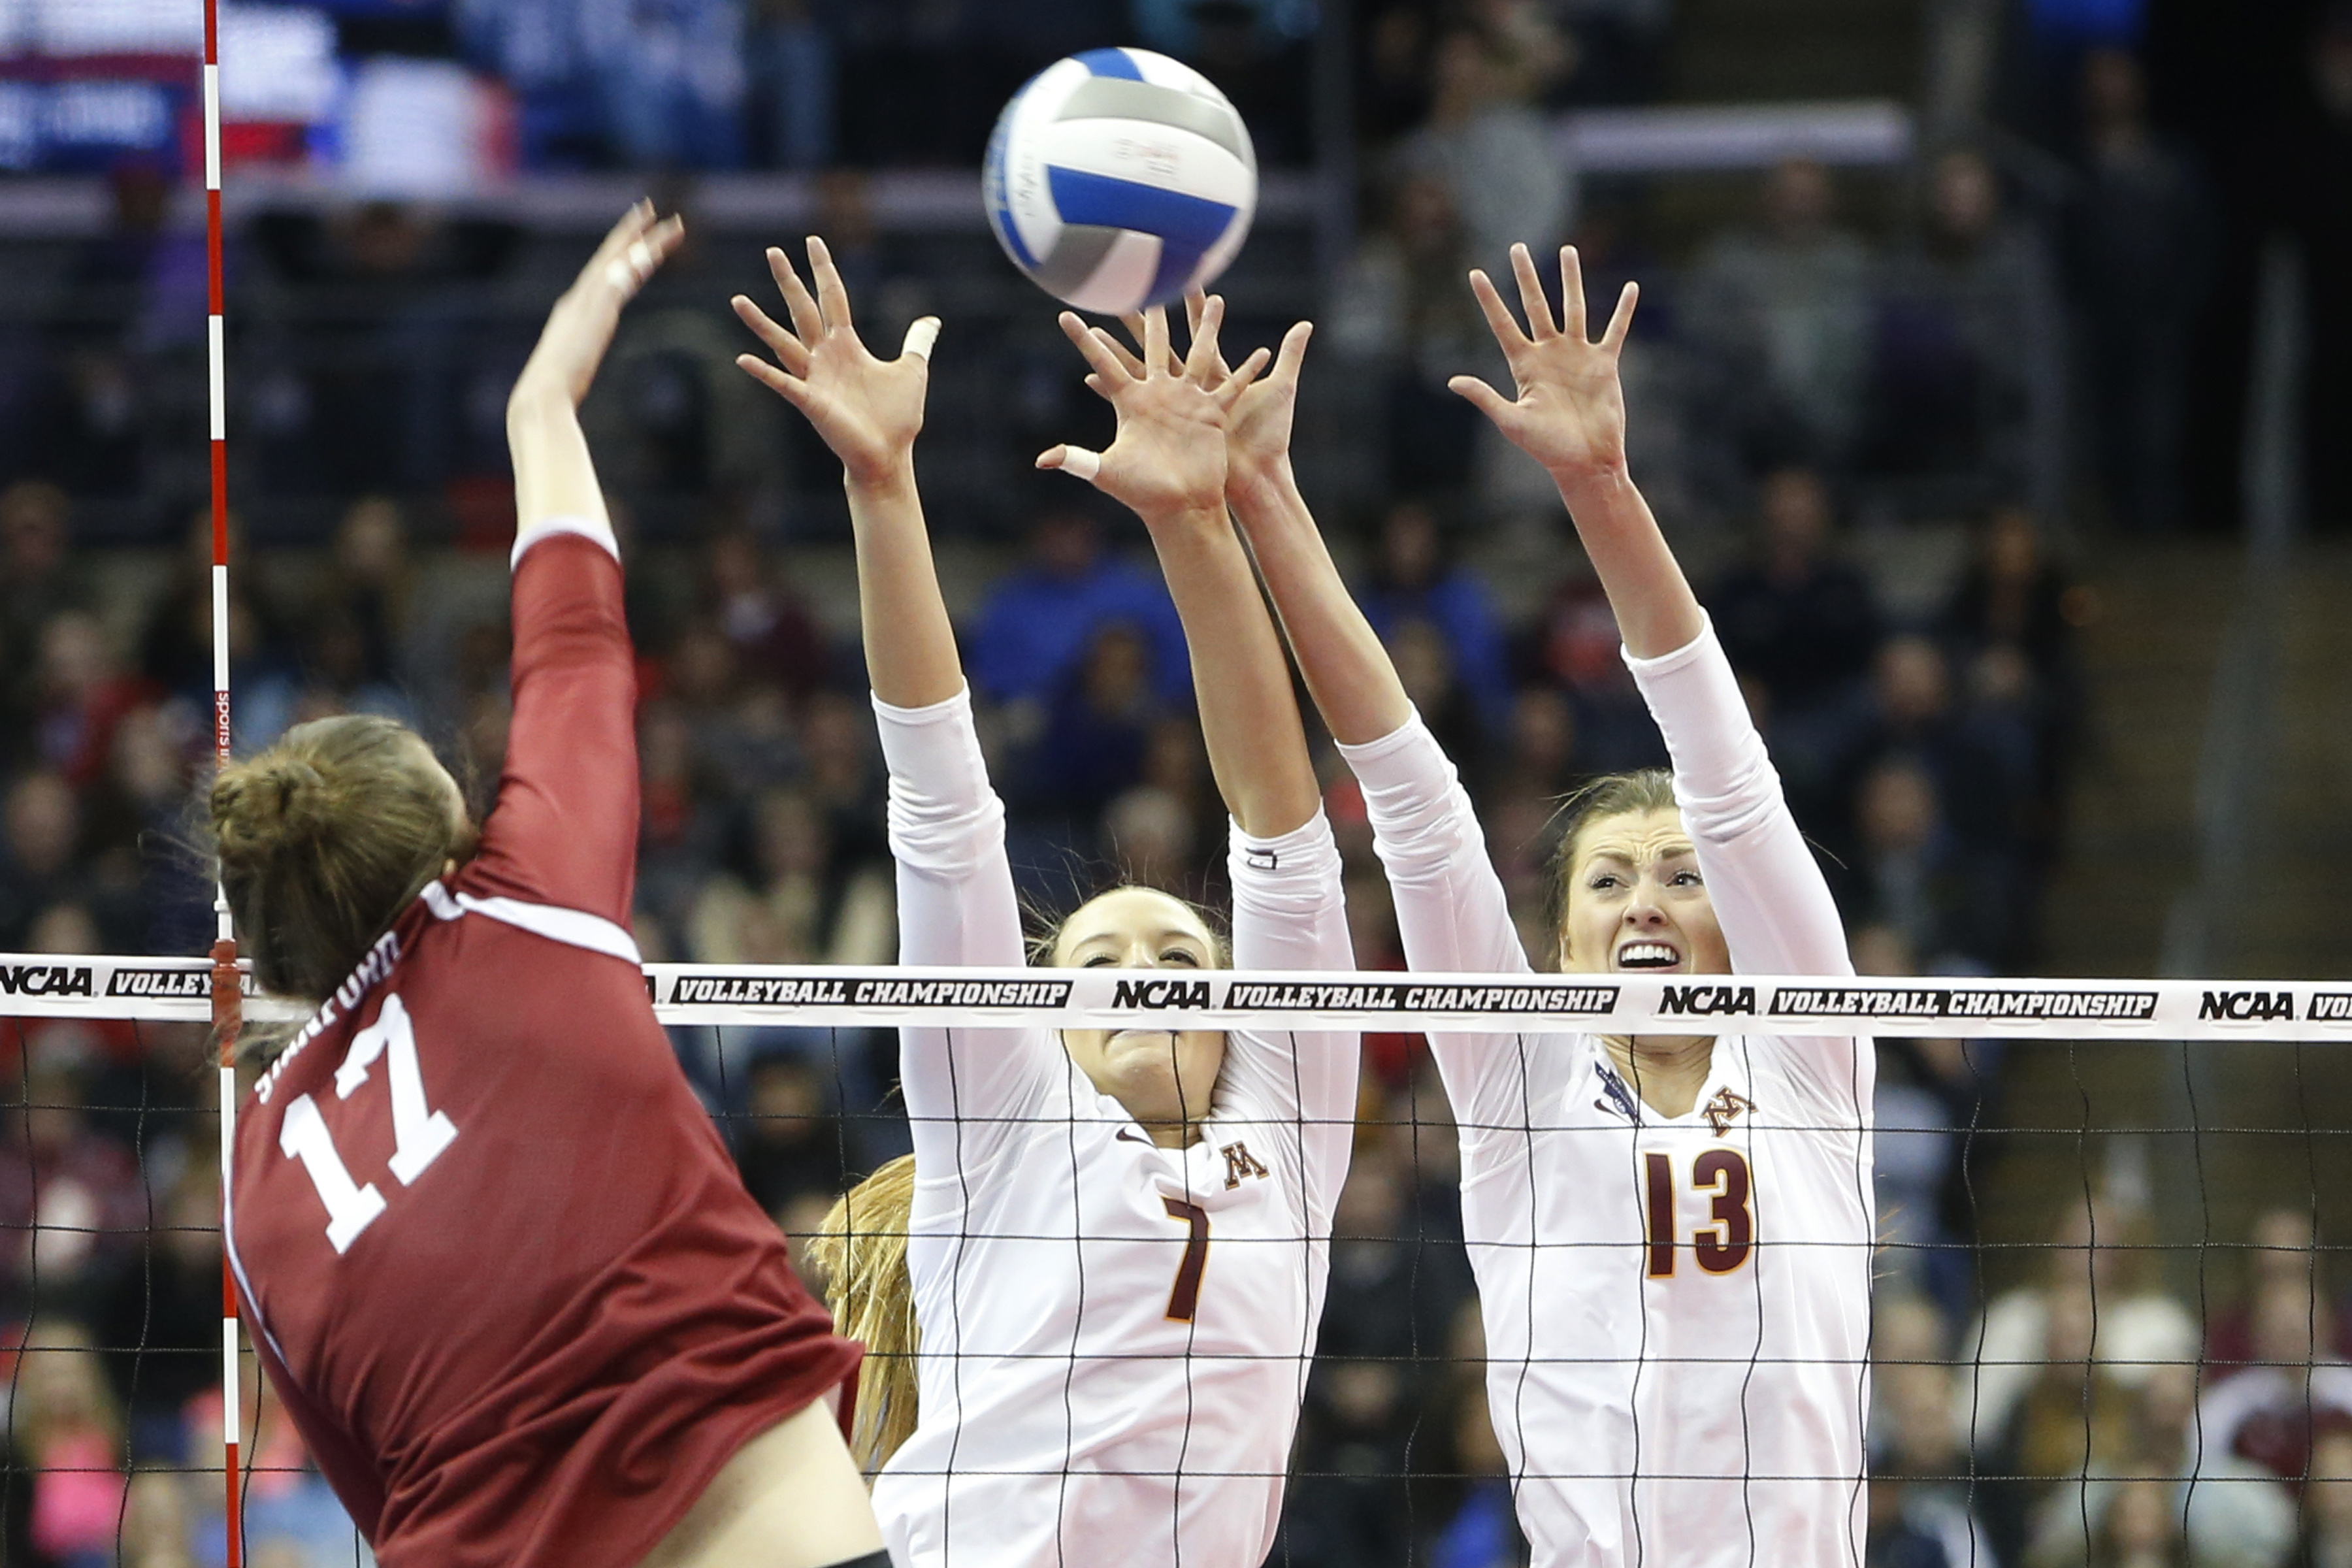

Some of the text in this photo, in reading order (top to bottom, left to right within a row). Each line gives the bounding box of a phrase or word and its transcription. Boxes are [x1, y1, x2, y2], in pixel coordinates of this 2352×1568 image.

[0, 966, 91, 996] NCAA
[679, 979, 846, 1002] VOLLEYBALL
[854, 982, 1069, 1005] CHAMPIONSHIP
[1111, 980, 1614, 1011] NCAA VOLLEYBALL CHAMPIONSHIP
[1658, 987, 2154, 1017] NCAA VOLLEYBALL CHAMPIONSHIP
[2198, 991, 2293, 1020] NCAA
[279, 992, 459, 1255] 17
[1644, 1149, 1754, 1279] 13
[1162, 1195, 1212, 1324] 7
